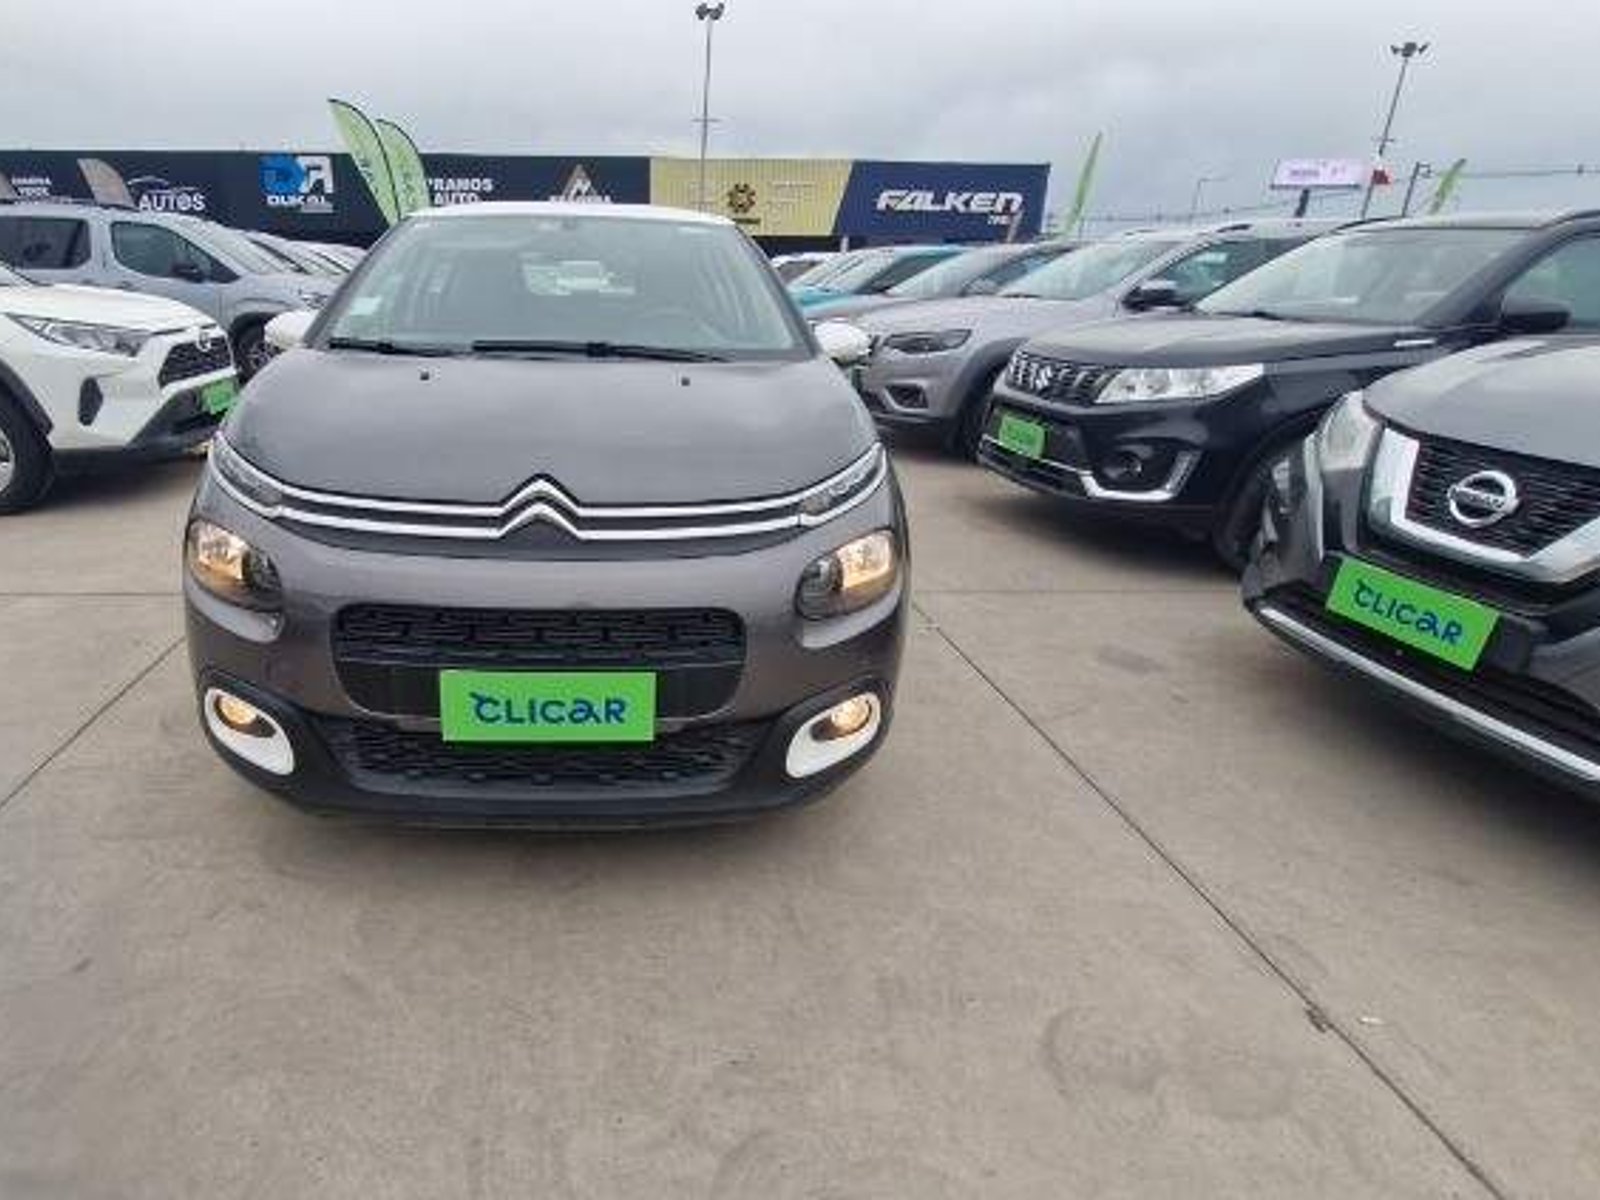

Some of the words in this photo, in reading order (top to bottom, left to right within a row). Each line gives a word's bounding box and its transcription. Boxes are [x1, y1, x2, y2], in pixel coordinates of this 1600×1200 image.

[428, 178, 493, 192] RAMOS
[140, 192, 205, 211] AUTOS
[876, 189, 1023, 214] FALKEN
